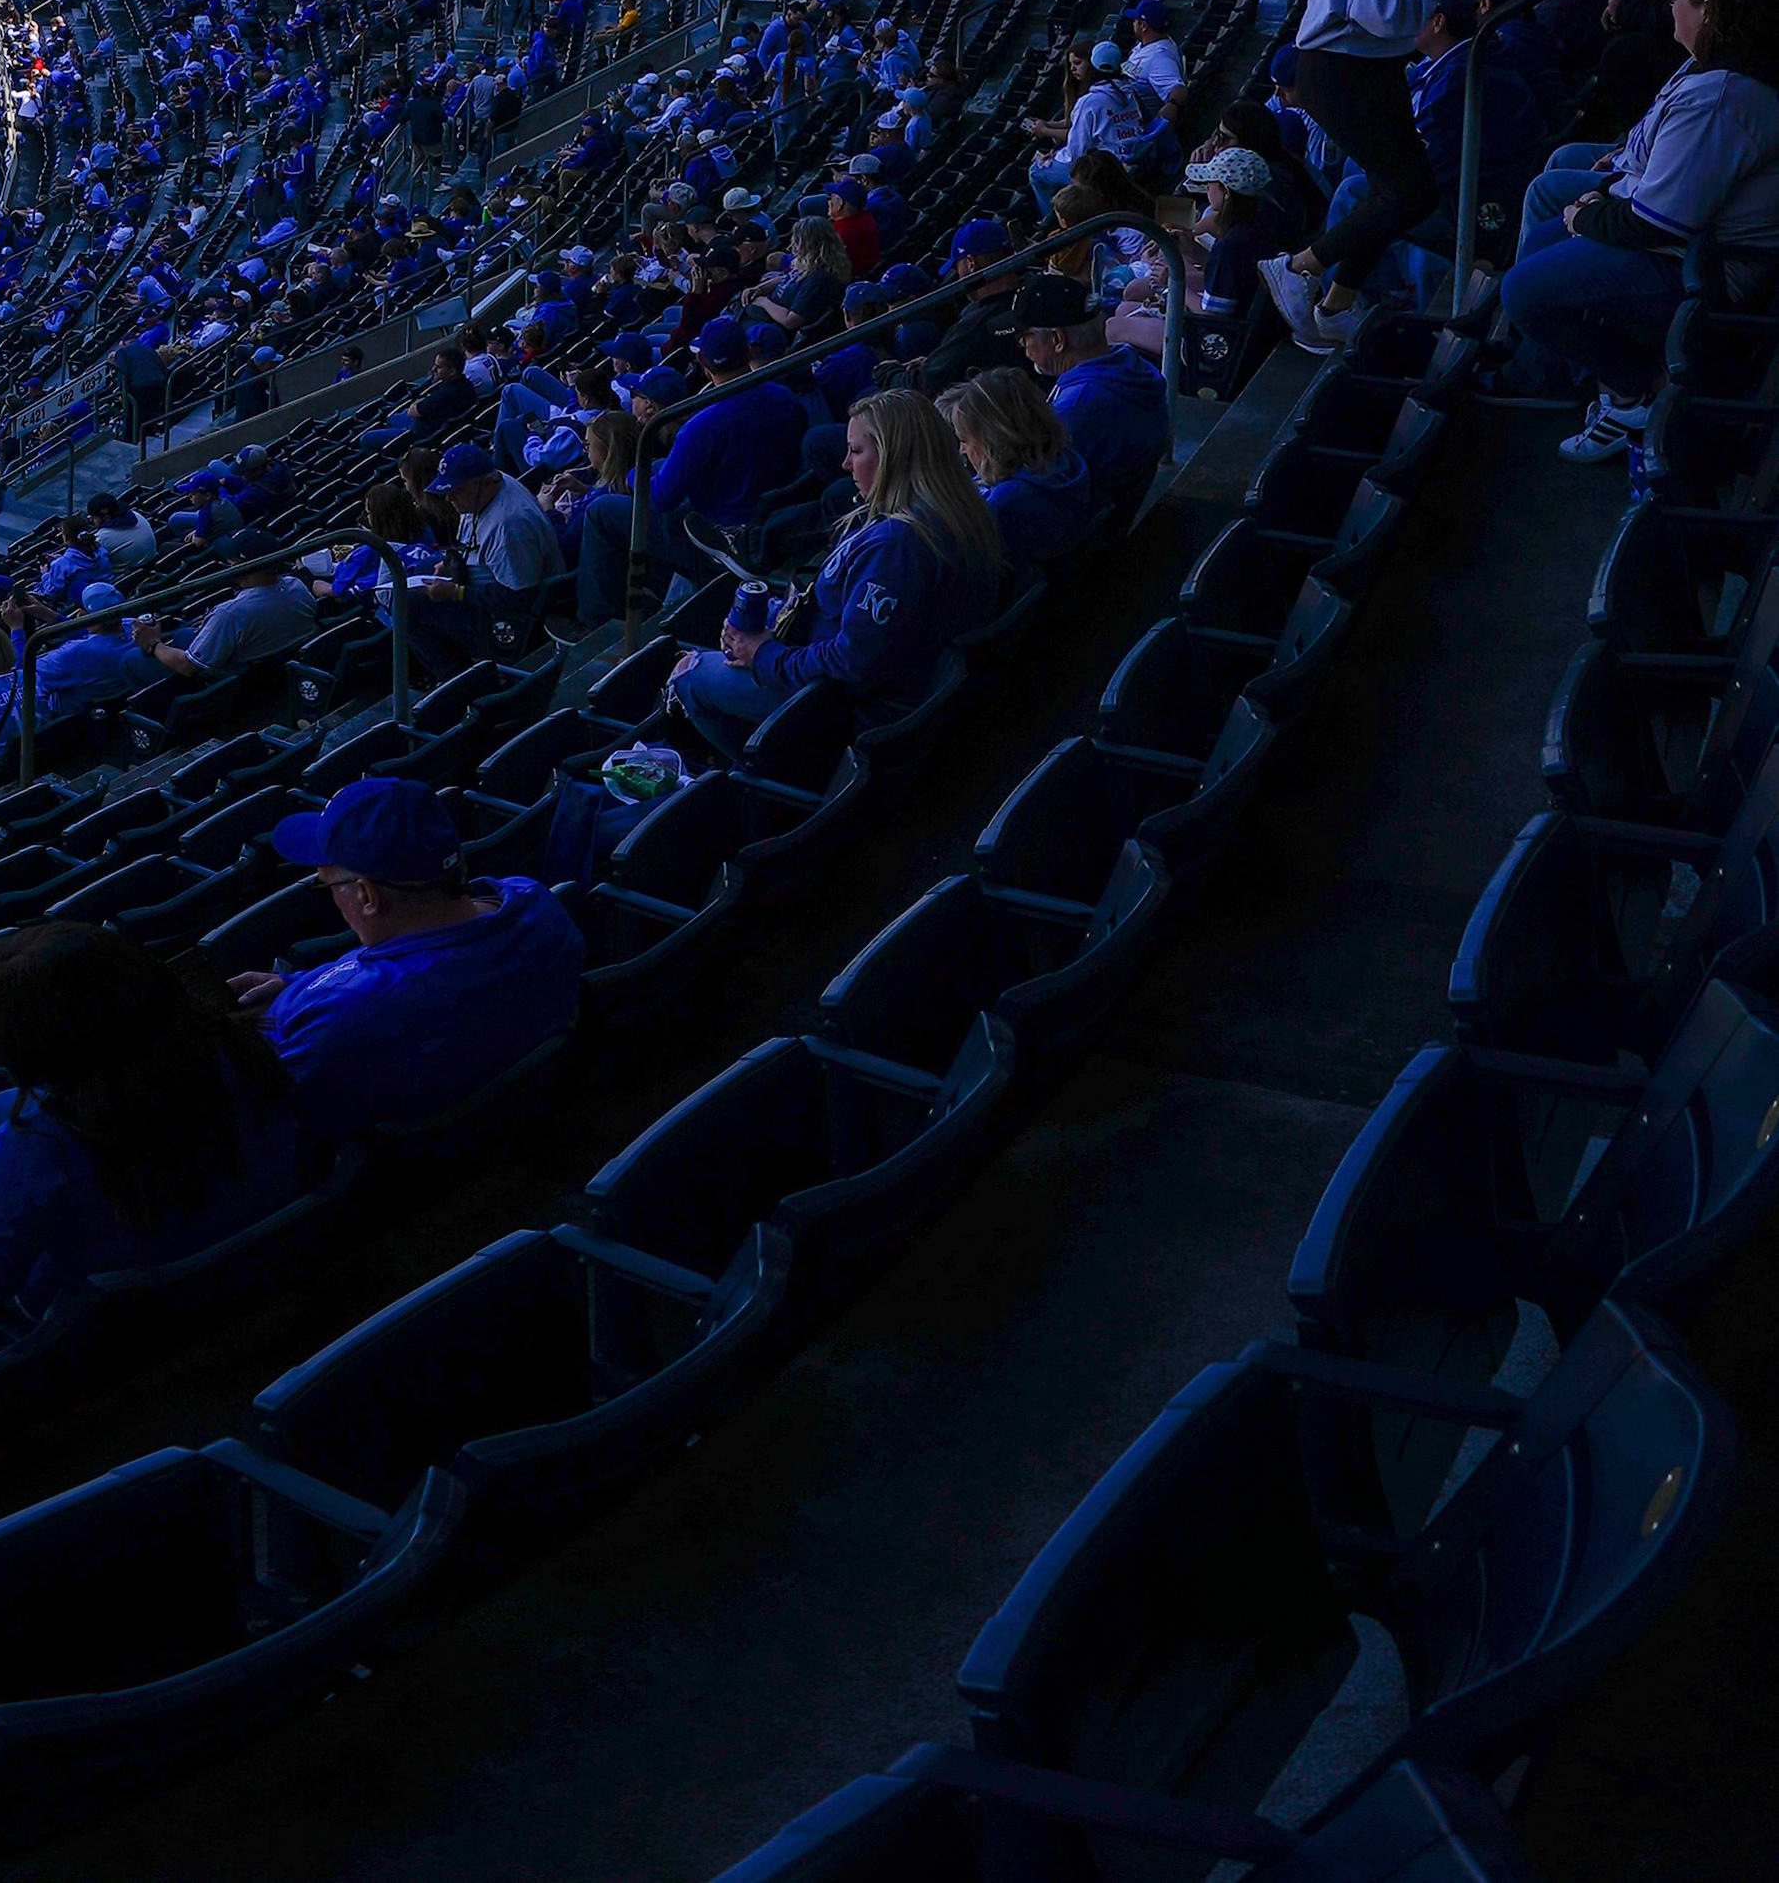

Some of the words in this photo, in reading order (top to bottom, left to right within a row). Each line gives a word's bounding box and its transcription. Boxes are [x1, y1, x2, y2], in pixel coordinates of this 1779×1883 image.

[58, 389, 74, 408] 422
[30, 407, 46, 425] 421
[857, 581, 898, 626] KC
